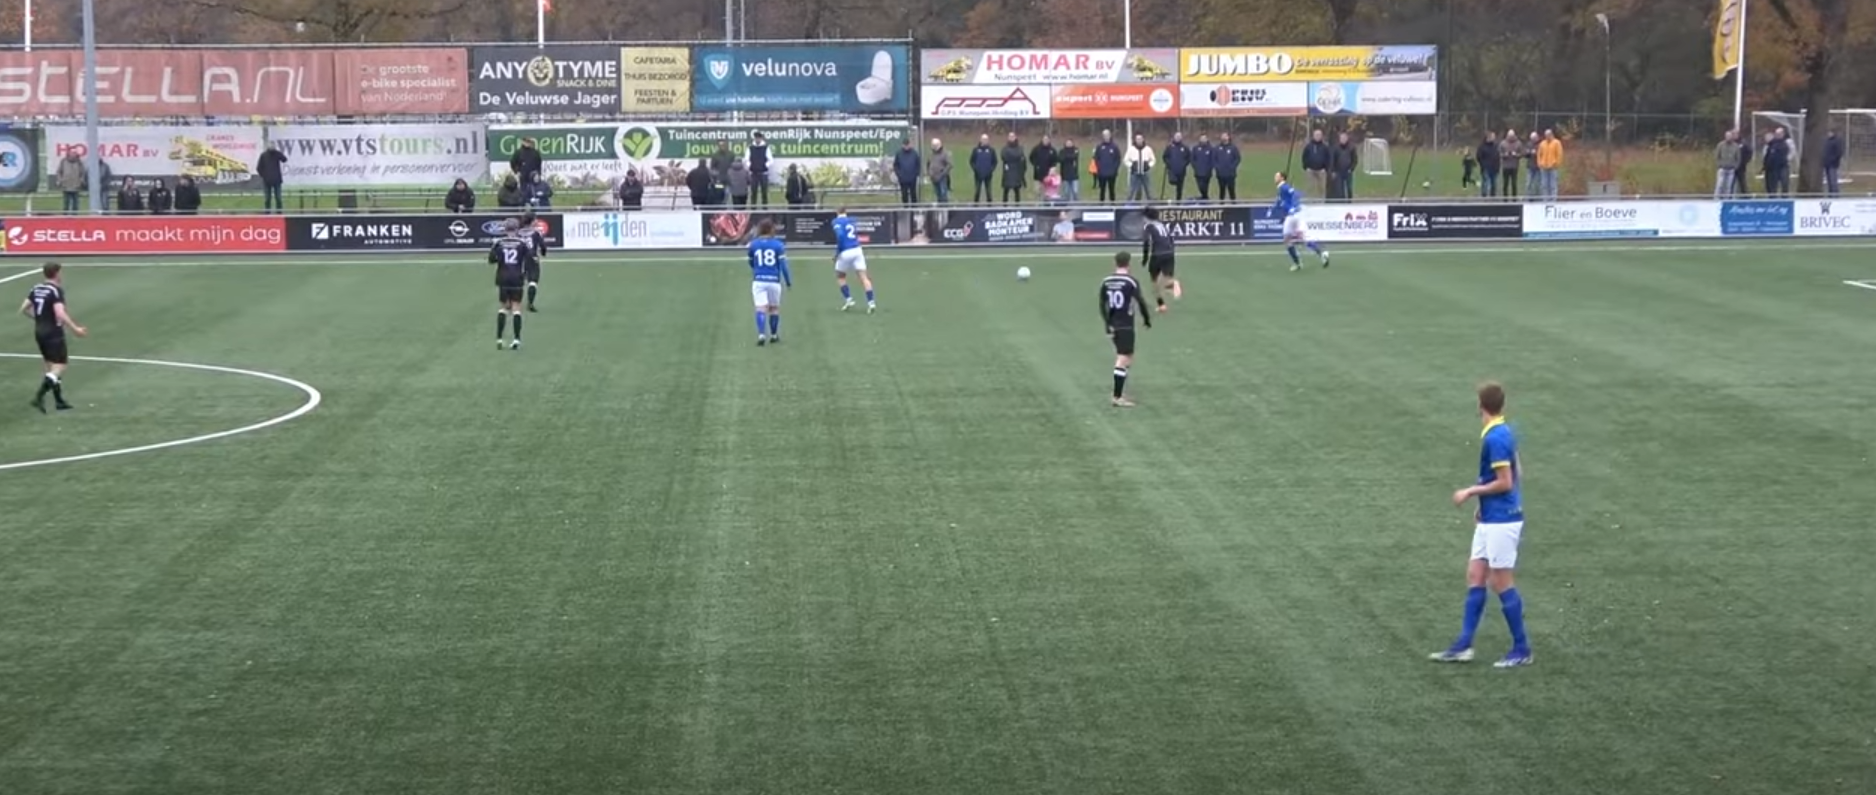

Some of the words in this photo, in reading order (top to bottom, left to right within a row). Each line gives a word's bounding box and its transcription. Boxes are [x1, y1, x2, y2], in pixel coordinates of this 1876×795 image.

[479, 61, 527, 79] ANY
[554, 60, 617, 78] TYME
[741, 57, 838, 77] velunova
[985, 54, 1090, 71] HOMAR
[1095, 60, 1115, 70] BV
[1186, 53, 1292, 76] JUMBO
[379, 64, 429, 76] grootste
[993, 73, 1037, 81] Nunspeet
[1042, 73, 1109, 81] www.homar.nl
[360, 78, 398, 88] e-bike
[400, 77, 457, 89] specialist
[556, 79, 587, 88] SNACK
[596, 79, 617, 88] DINE
[479, 92, 500, 105] De
[505, 92, 569, 105] Veluwse
[573, 92, 618, 107] Jager
[634, 89, 669, 97] FEESTEN
[668, 129, 747, 140] Tuincentrum
[813, 128, 900, 141] Nunspeet/Epe
[277, 131, 478, 156] www.vtstours.nl
[780, 141, 884, 155] tuincentrum!
[371, 162, 381, 173] in
[382, 161, 477, 177] personenvervoer
[996, 211, 1023, 221] WORD
[1545, 206, 1575, 219] Flier
[1580, 210, 1593, 218] en
[1595, 206, 1637, 218] Boeve
[984, 217, 1034, 229] BADKAMER
[1230, 222, 1245, 236] 11
[1306, 221, 1379, 230] WIESSENBERG
[1800, 216, 1850, 229] BRIVEC
[33, 231, 106, 242] STELLA
[116, 225, 184, 241] maakt
[190, 226, 235, 244] mijn
[240, 225, 281, 244] dag
[333, 224, 412, 237] FRANKEN
[845, 224, 857, 239] 2
[943, 229, 964, 238] ECG
[988, 226, 1030, 237] MONTEUR
[503, 248, 518, 264] 12
[754, 249, 776, 266] 18
[34, 298, 45, 315] 7
[1106, 290, 1125, 309] 10
